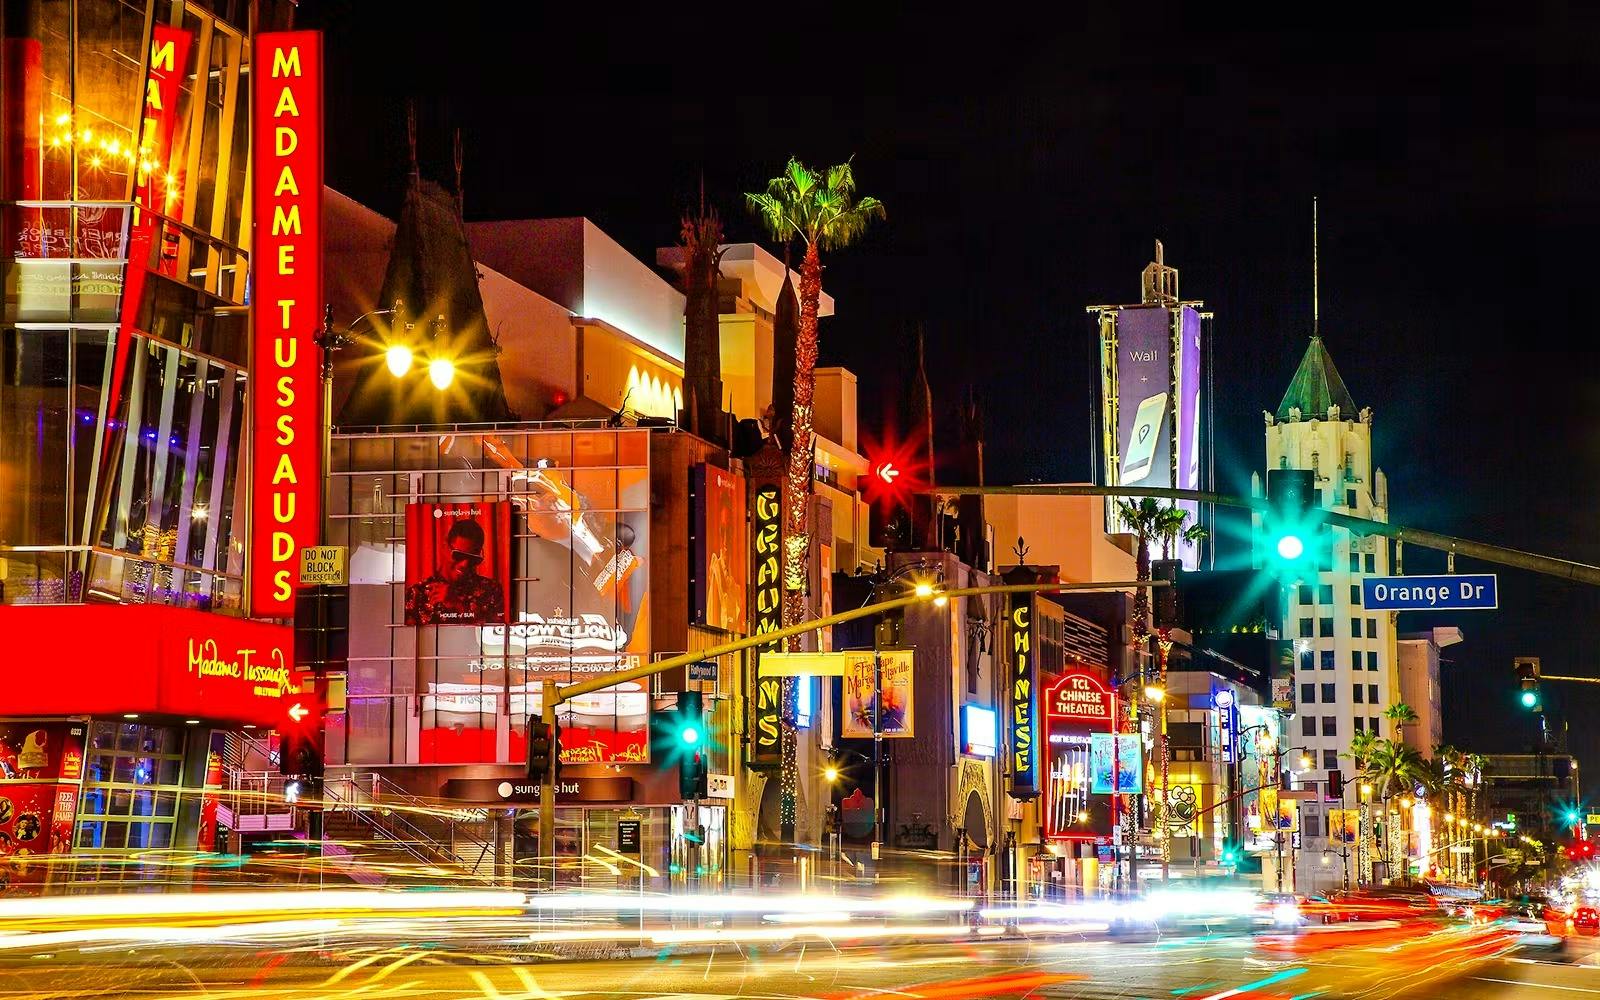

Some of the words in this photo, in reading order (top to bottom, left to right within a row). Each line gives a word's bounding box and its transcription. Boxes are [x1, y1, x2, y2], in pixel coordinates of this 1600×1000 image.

[271, 47, 302, 275] MADAME
[1129, 350, 1158, 361] Wall
[273, 299, 298, 602] TUSSAUDS
[305, 550, 317, 560] DO
[320, 550, 337, 560] NOT
[306, 563, 334, 572] BLOCK
[1374, 583, 1450, 605] Orange
[1460, 582, 1484, 599] Dr
[756, 491, 779, 745] GRAUMNS
[188, 638, 241, 679] Madame
[237, 648, 292, 694] Tussauds
[1013, 606, 1031, 773] CHINESE
[1072, 678, 1090, 690] TCL
[1060, 690, 1102, 703] CHINESE
[1056, 702, 1105, 715] THEATRES
[515, 785, 559, 796] sungs
[562, 782, 579, 794] hut
[59, 802, 72, 811] THE
